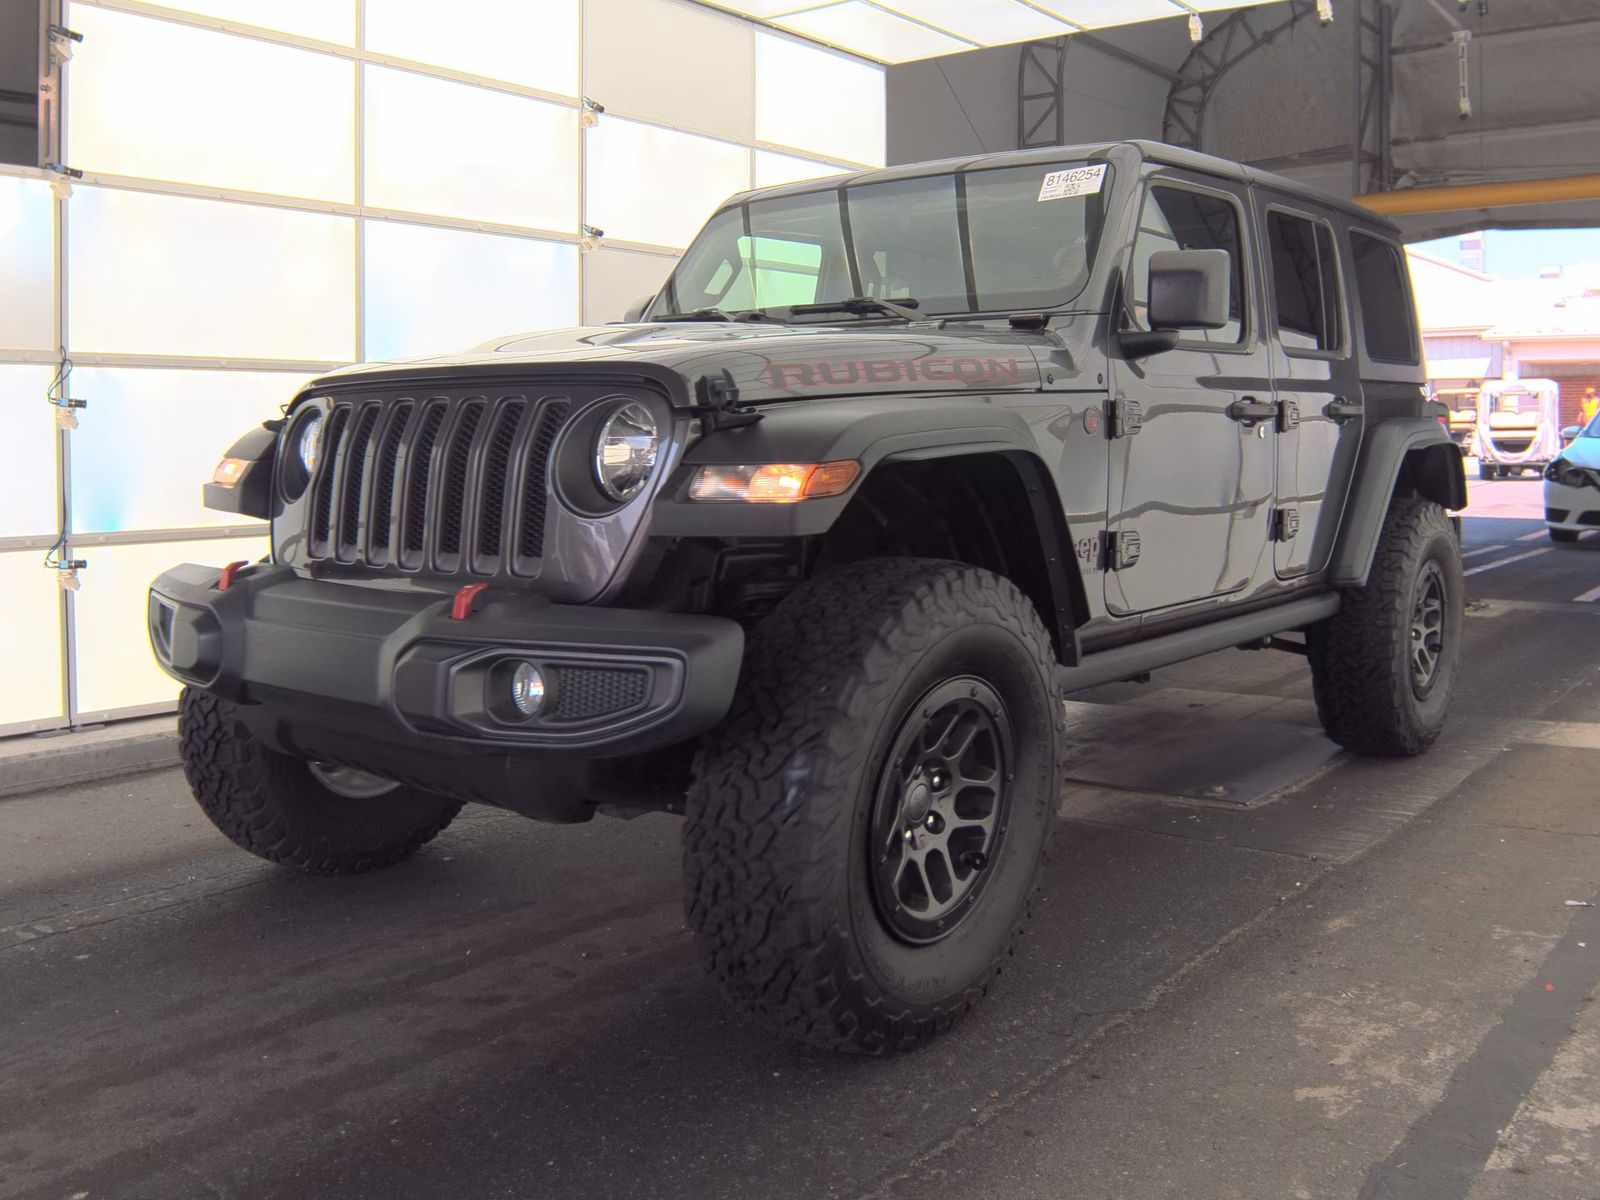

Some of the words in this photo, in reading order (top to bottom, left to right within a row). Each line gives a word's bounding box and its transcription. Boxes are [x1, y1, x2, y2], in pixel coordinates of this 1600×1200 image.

[1046, 167, 1102, 187] 8146254
[767, 357, 1022, 390] RUBICON
[1072, 537, 1100, 563] eep
